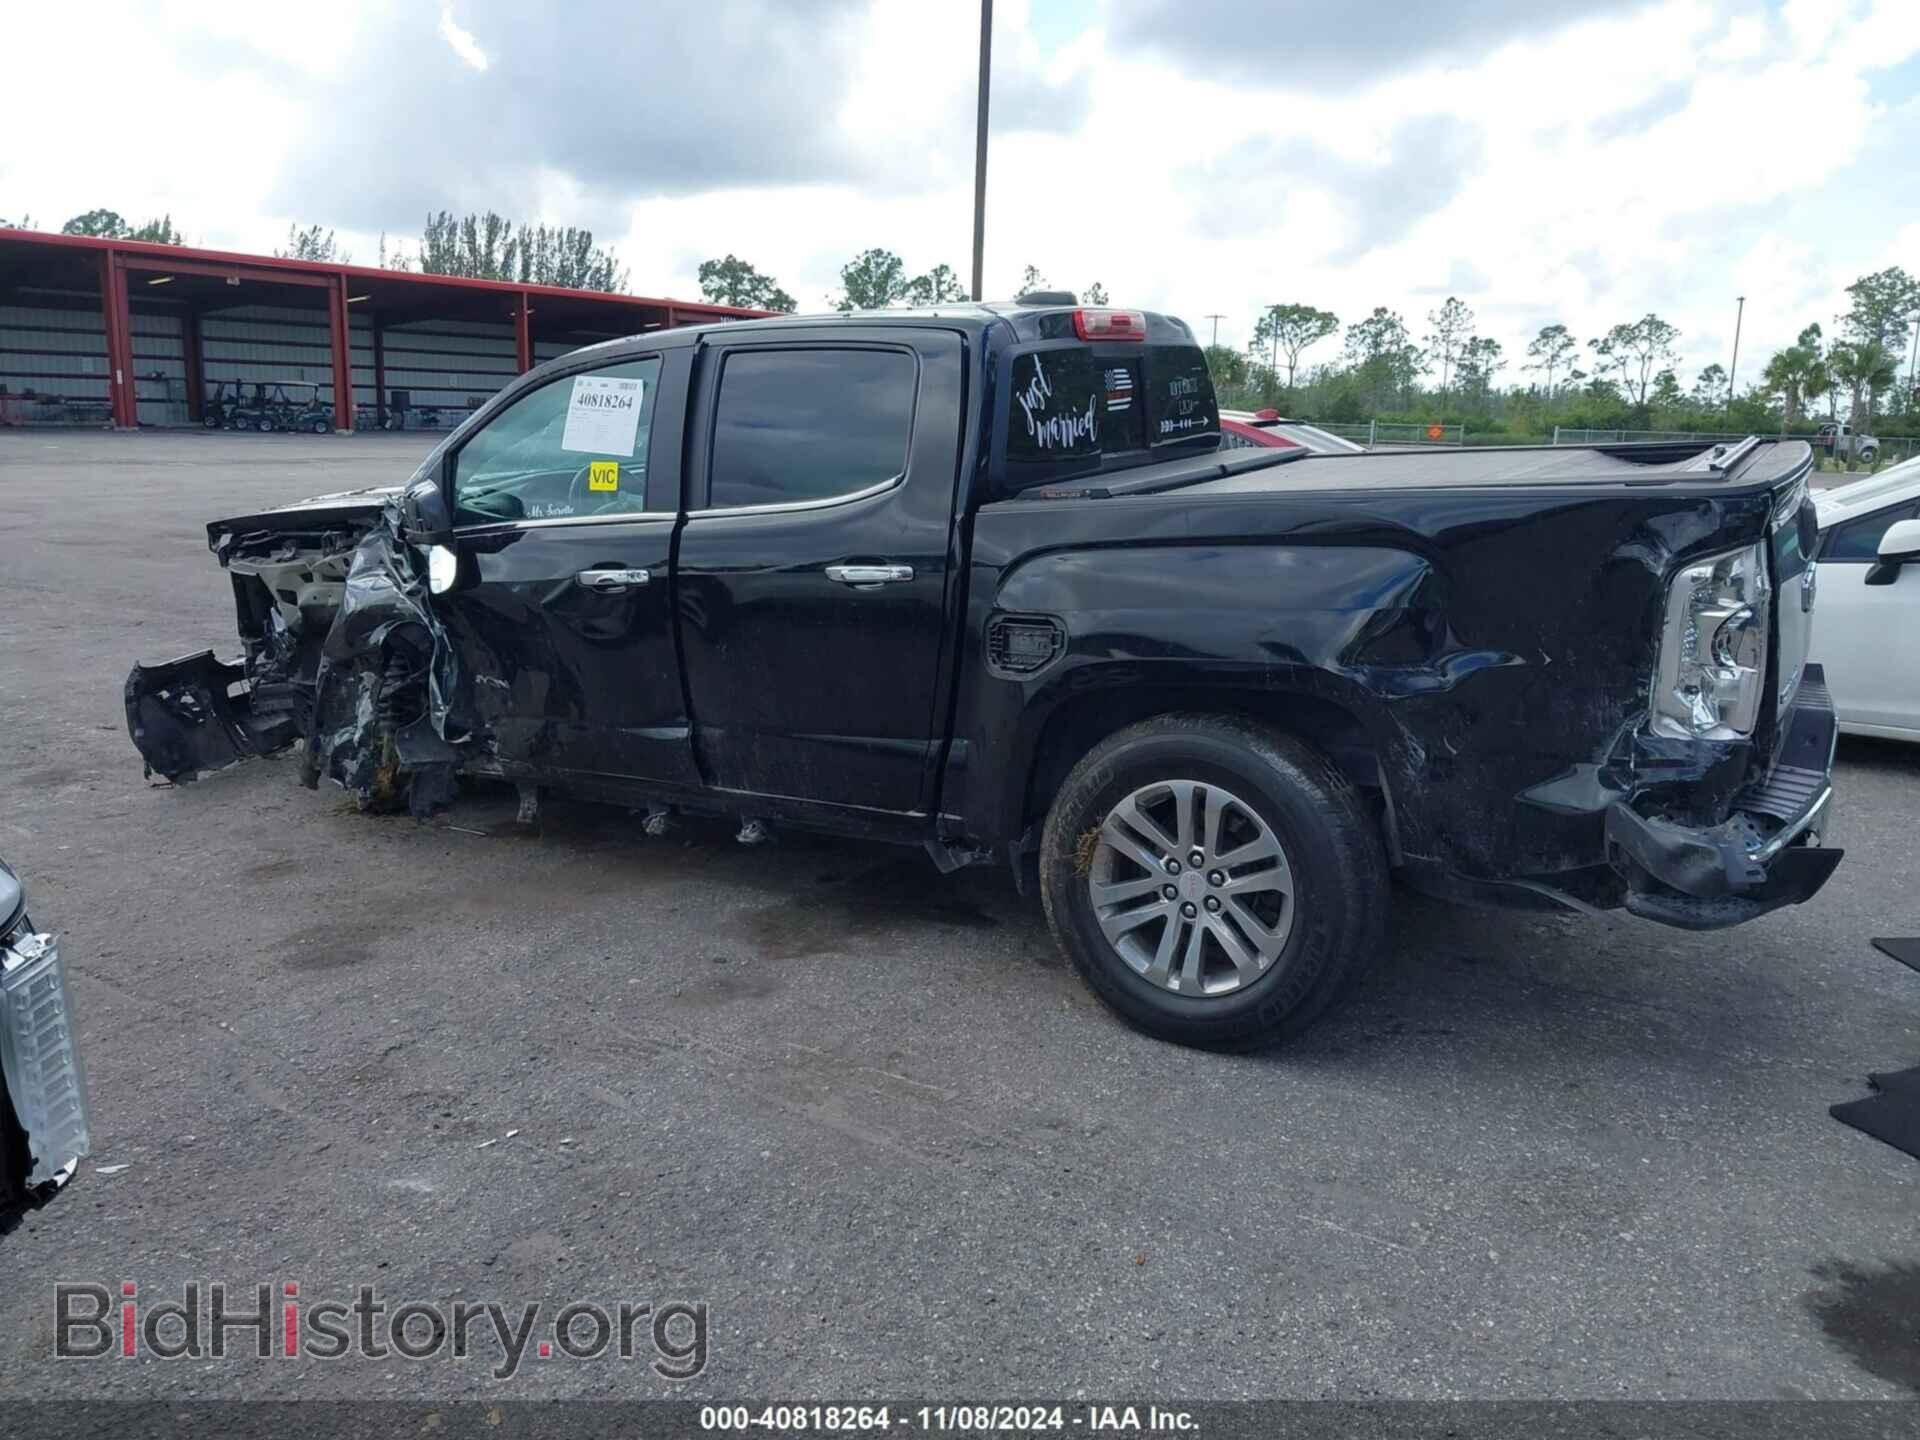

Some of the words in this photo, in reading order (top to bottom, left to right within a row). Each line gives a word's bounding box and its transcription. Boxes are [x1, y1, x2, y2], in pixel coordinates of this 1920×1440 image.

[577, 393, 633, 409] 40818264
[1016, 354, 1052, 435] just
[1036, 394, 1098, 449] married
[592, 469, 615, 484] VIC
